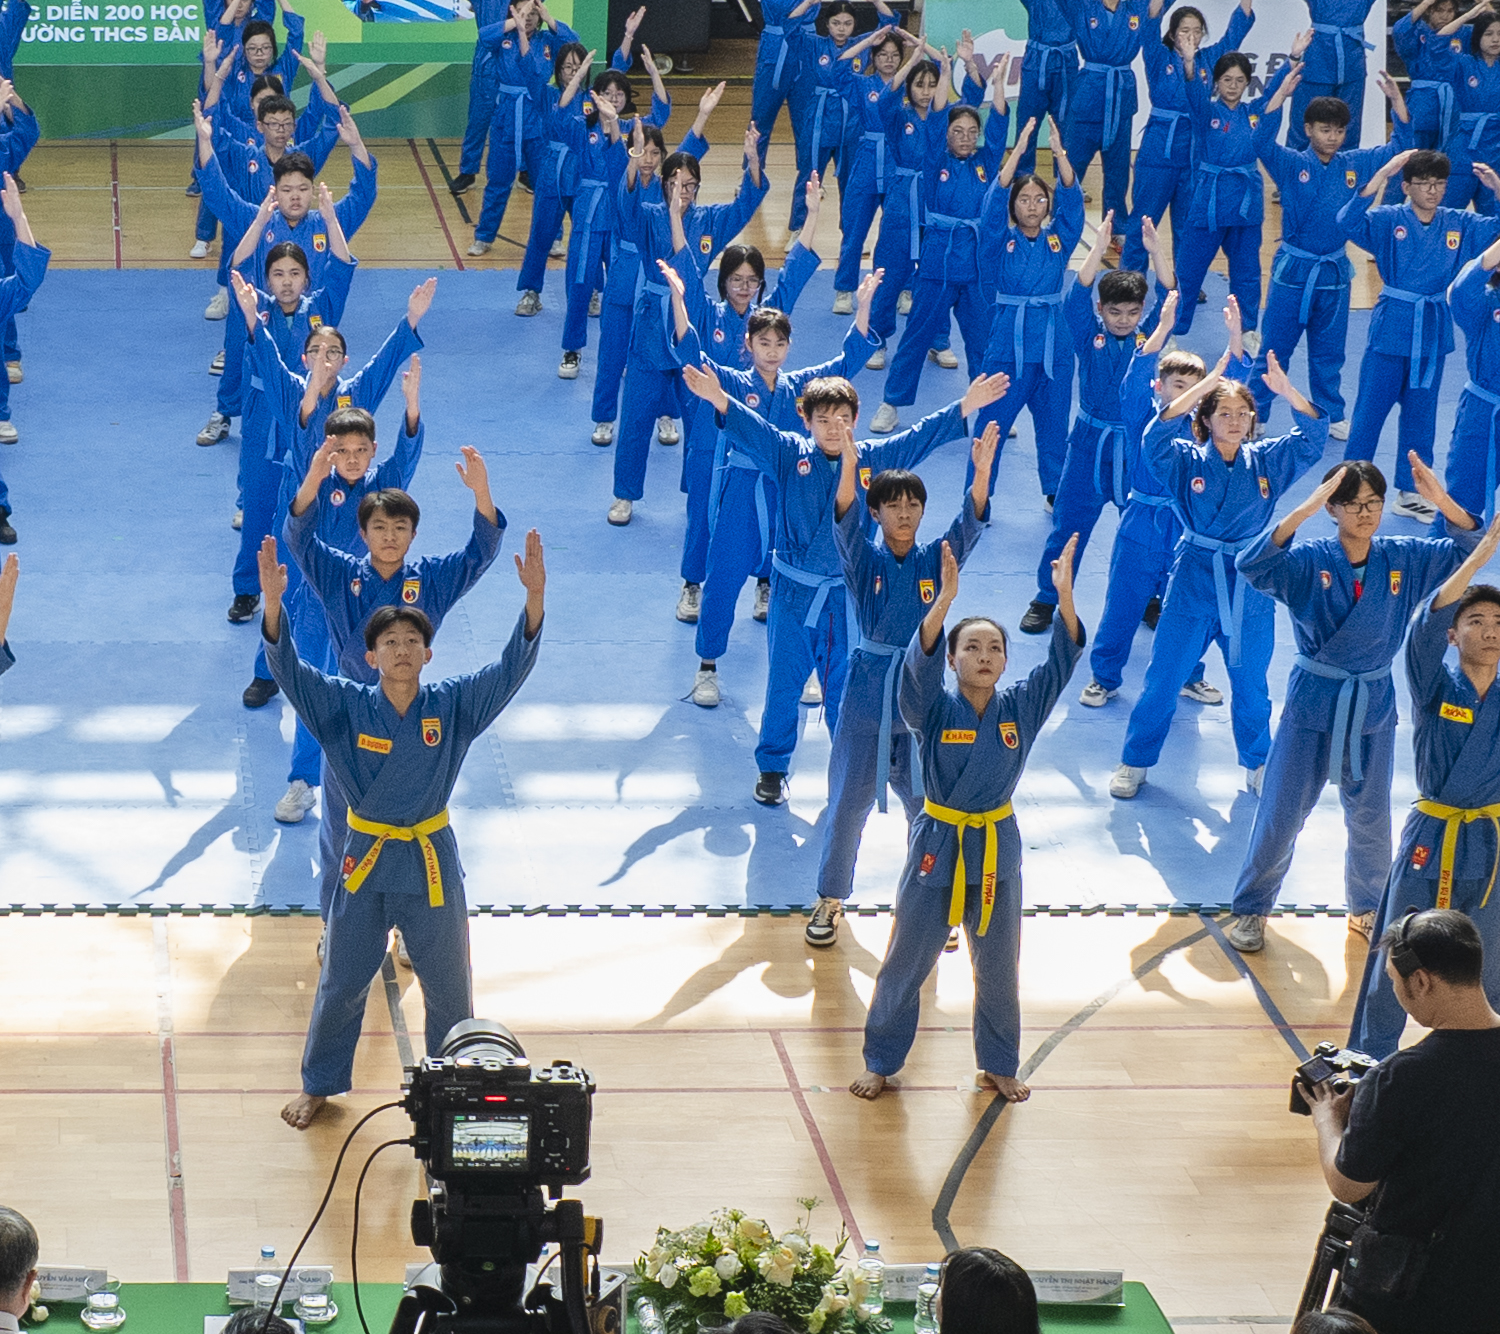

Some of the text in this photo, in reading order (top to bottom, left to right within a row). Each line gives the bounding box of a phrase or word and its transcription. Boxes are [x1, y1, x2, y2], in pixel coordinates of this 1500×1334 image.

[46, 0, 99, 21] DIỄN
[104, 4, 145, 21] 200
[150, 4, 199, 25] HỌC
[21, 22, 86, 43] ƯỜNG
[90, 26, 148, 43] THCS
[1033, 1275, 1059, 1284] GUYỄN
